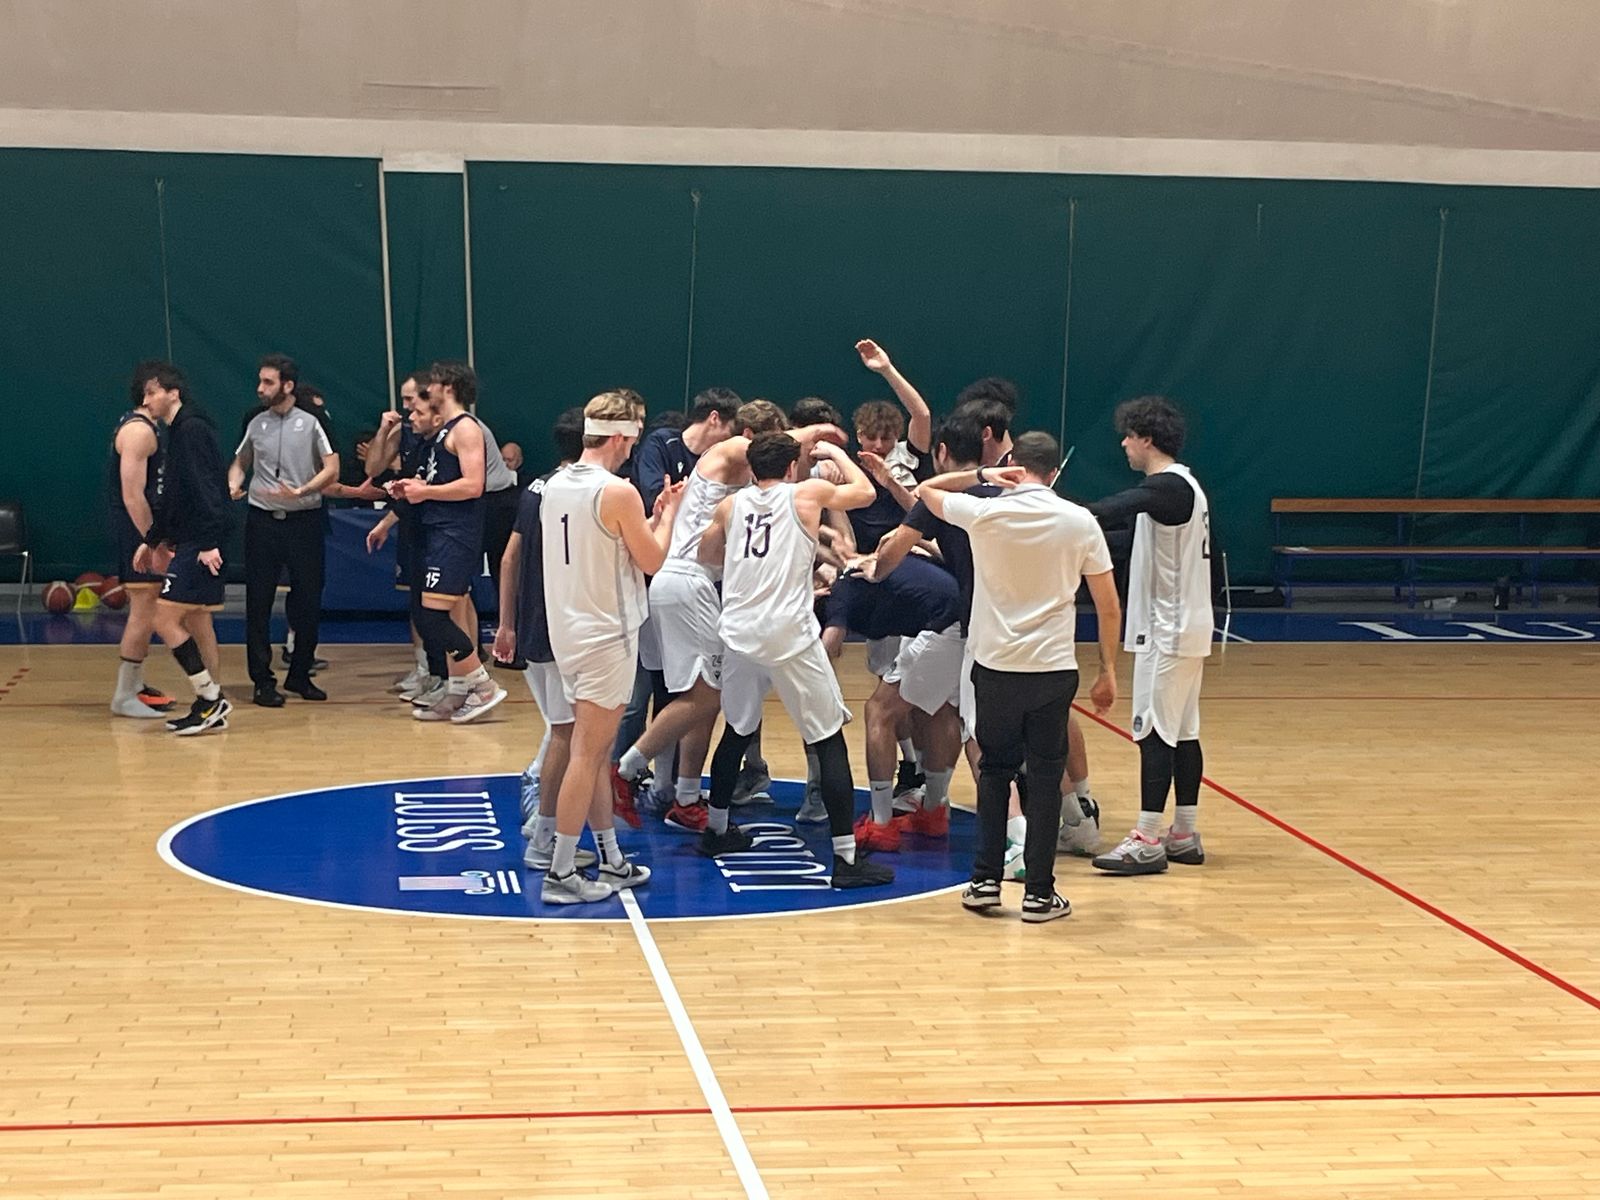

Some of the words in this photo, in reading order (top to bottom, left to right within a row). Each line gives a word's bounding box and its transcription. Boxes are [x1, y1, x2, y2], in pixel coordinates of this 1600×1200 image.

[560, 513, 570, 566] 1
[743, 512, 773, 559] 15
[425, 571, 441, 589] 15
[1337, 621, 1600, 640] LU
[394, 791, 505, 852] LUISS
